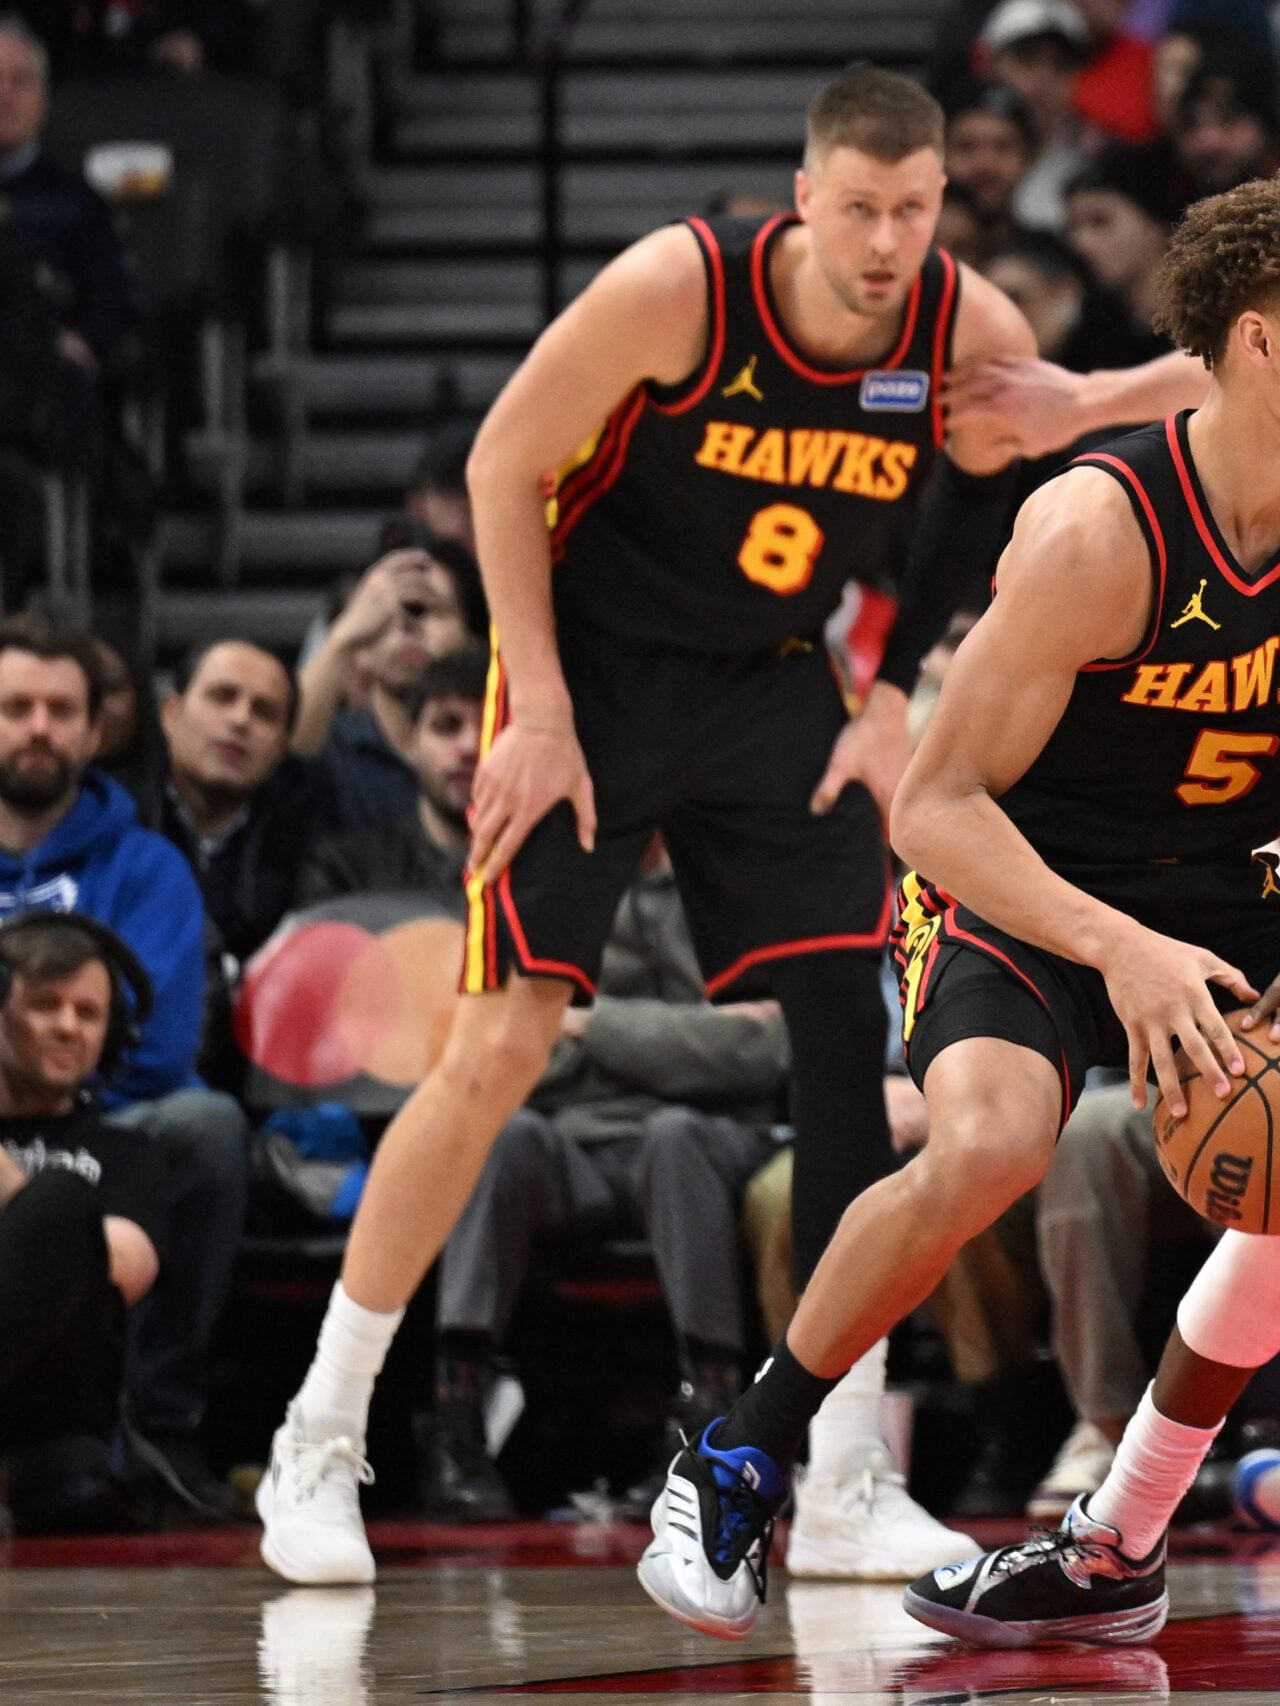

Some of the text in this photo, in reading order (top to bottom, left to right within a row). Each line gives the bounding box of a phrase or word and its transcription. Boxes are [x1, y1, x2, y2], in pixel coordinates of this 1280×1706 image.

[695, 421, 918, 501] HAWKS
[737, 503, 825, 596] 8
[1174, 728, 1280, 805] 5
